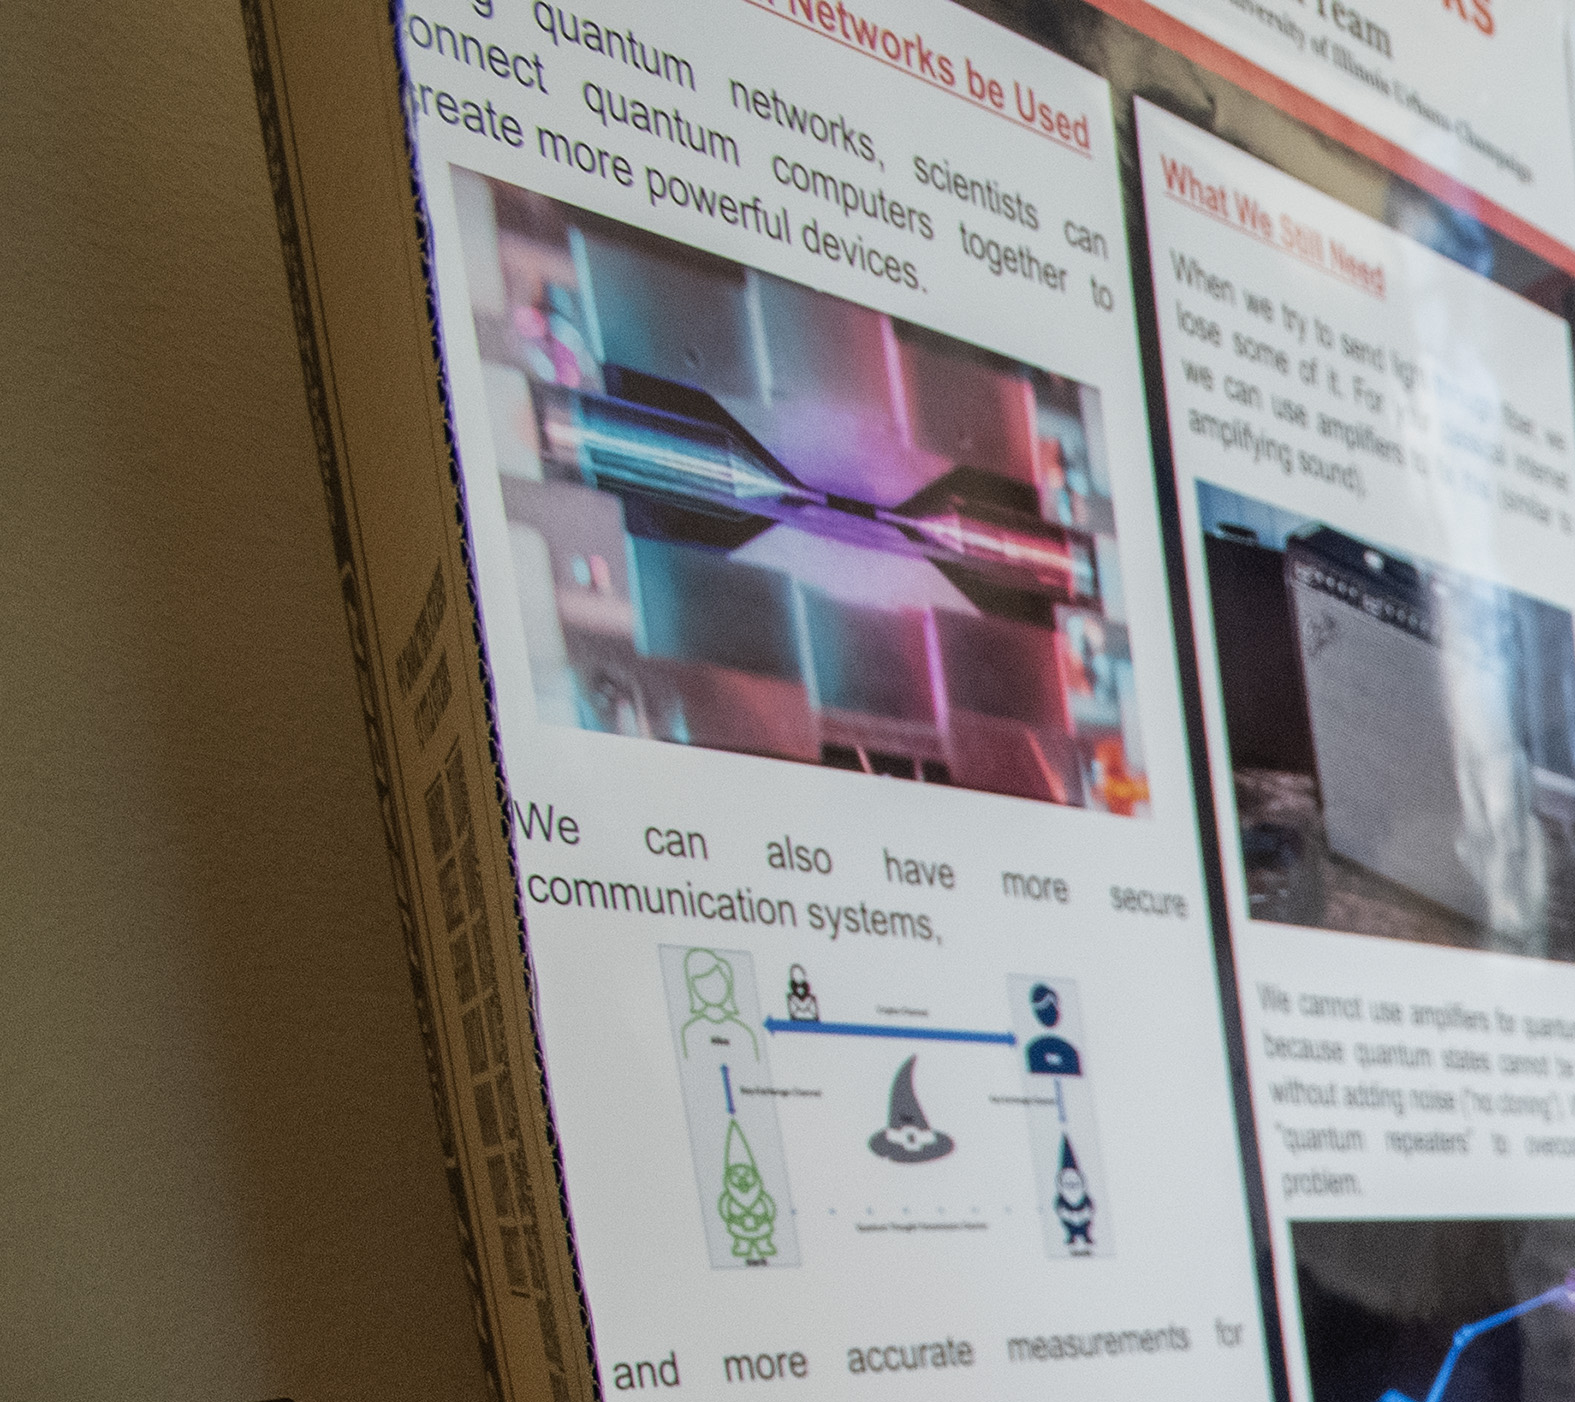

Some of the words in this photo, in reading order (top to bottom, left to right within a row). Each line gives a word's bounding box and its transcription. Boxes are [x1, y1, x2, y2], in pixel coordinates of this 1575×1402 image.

[532, 0, 697, 92] quantum
[728, 78, 884, 171] networks,
[912, 155, 1039, 231] scientists
[1063, 219, 1107, 258] can
[788, 0, 957, 88] Networks
[964, 56, 1004, 110] be
[1013, 80, 1090, 149] Used
[404, 8, 551, 97] onnect
[582, 80, 740, 167] quantum
[771, 154, 934, 240] computers
[958, 221, 1067, 291] together
[1089, 276, 1114, 311] to
[413, 78, 526, 150] reate
[536, 126, 633, 187] more
[644, 166, 791, 244] powerful
[801, 218, 929, 293] devices.
[514, 800, 581, 846] We
[643, 825, 709, 860] can
[765, 834, 833, 875] also
[882, 847, 955, 890] have
[1001, 871, 1069, 904] more
[1109, 885, 1187, 918] secure
[526, 869, 797, 928] communication
[806, 901, 941, 944] systems,
[611, 1349, 681, 1391] and
[722, 1350, 809, 1383] more
[846, 1337, 975, 1375] accurate
[1006, 1325, 1191, 1361] measurements
[1214, 1319, 1242, 1347] for
